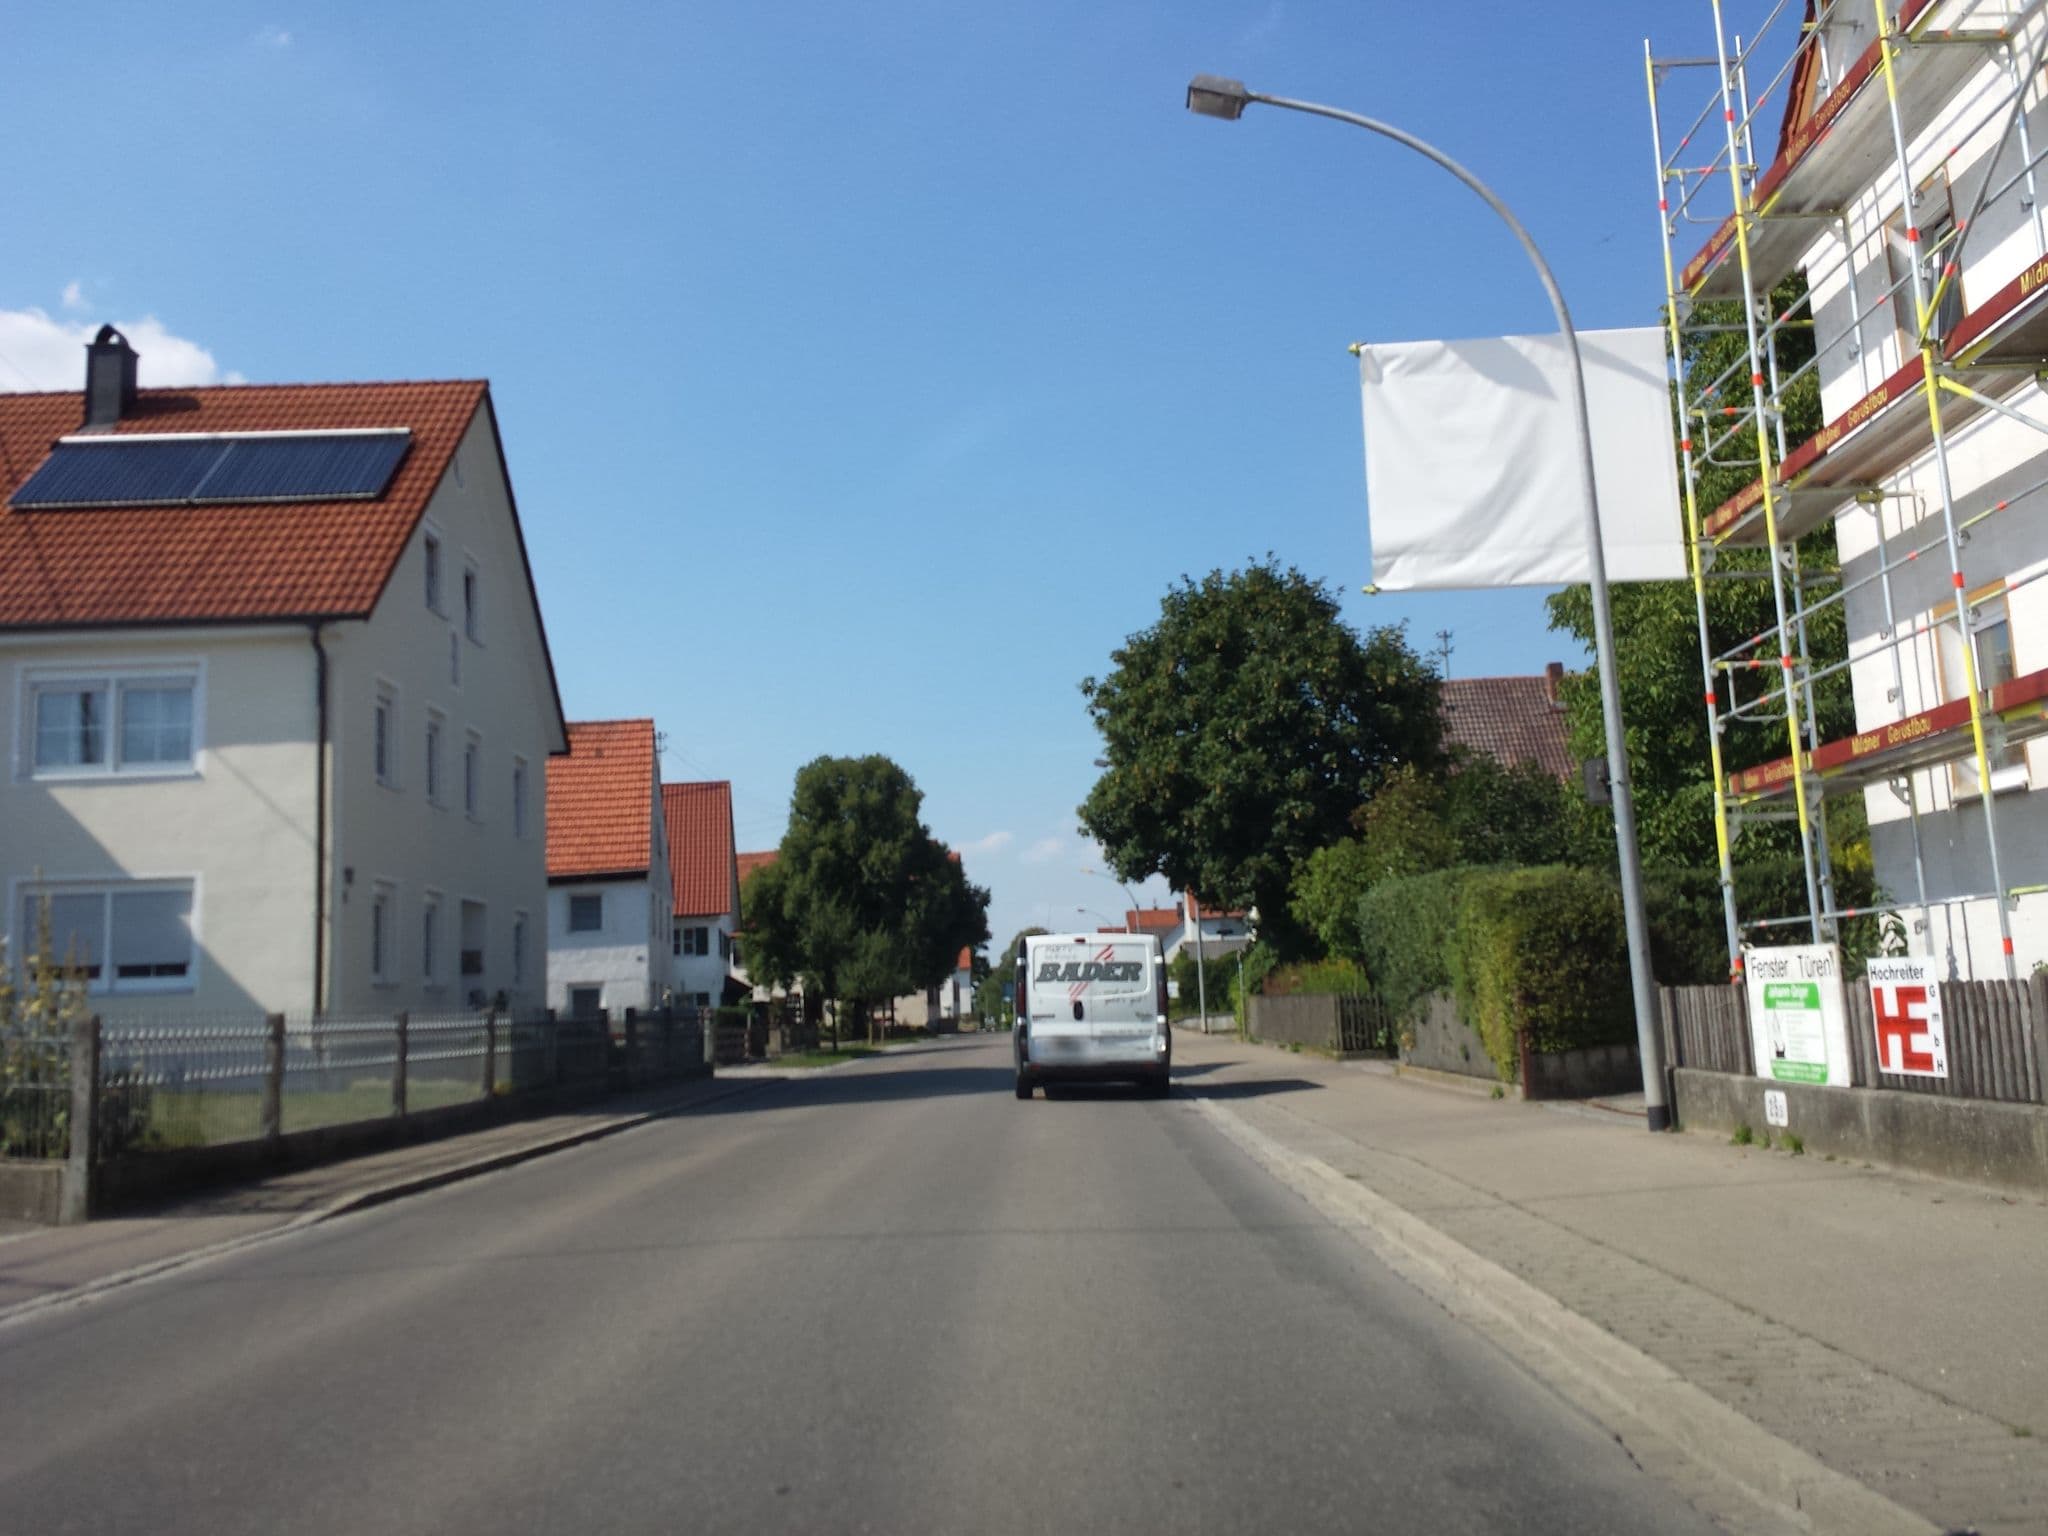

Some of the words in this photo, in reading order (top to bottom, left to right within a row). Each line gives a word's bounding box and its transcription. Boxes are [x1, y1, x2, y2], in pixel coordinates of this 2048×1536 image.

[1035, 962, 1142, 981] BADER
[1751, 956, 1789, 979] Fenster
[1869, 964, 1924, 980] Hochreiter
